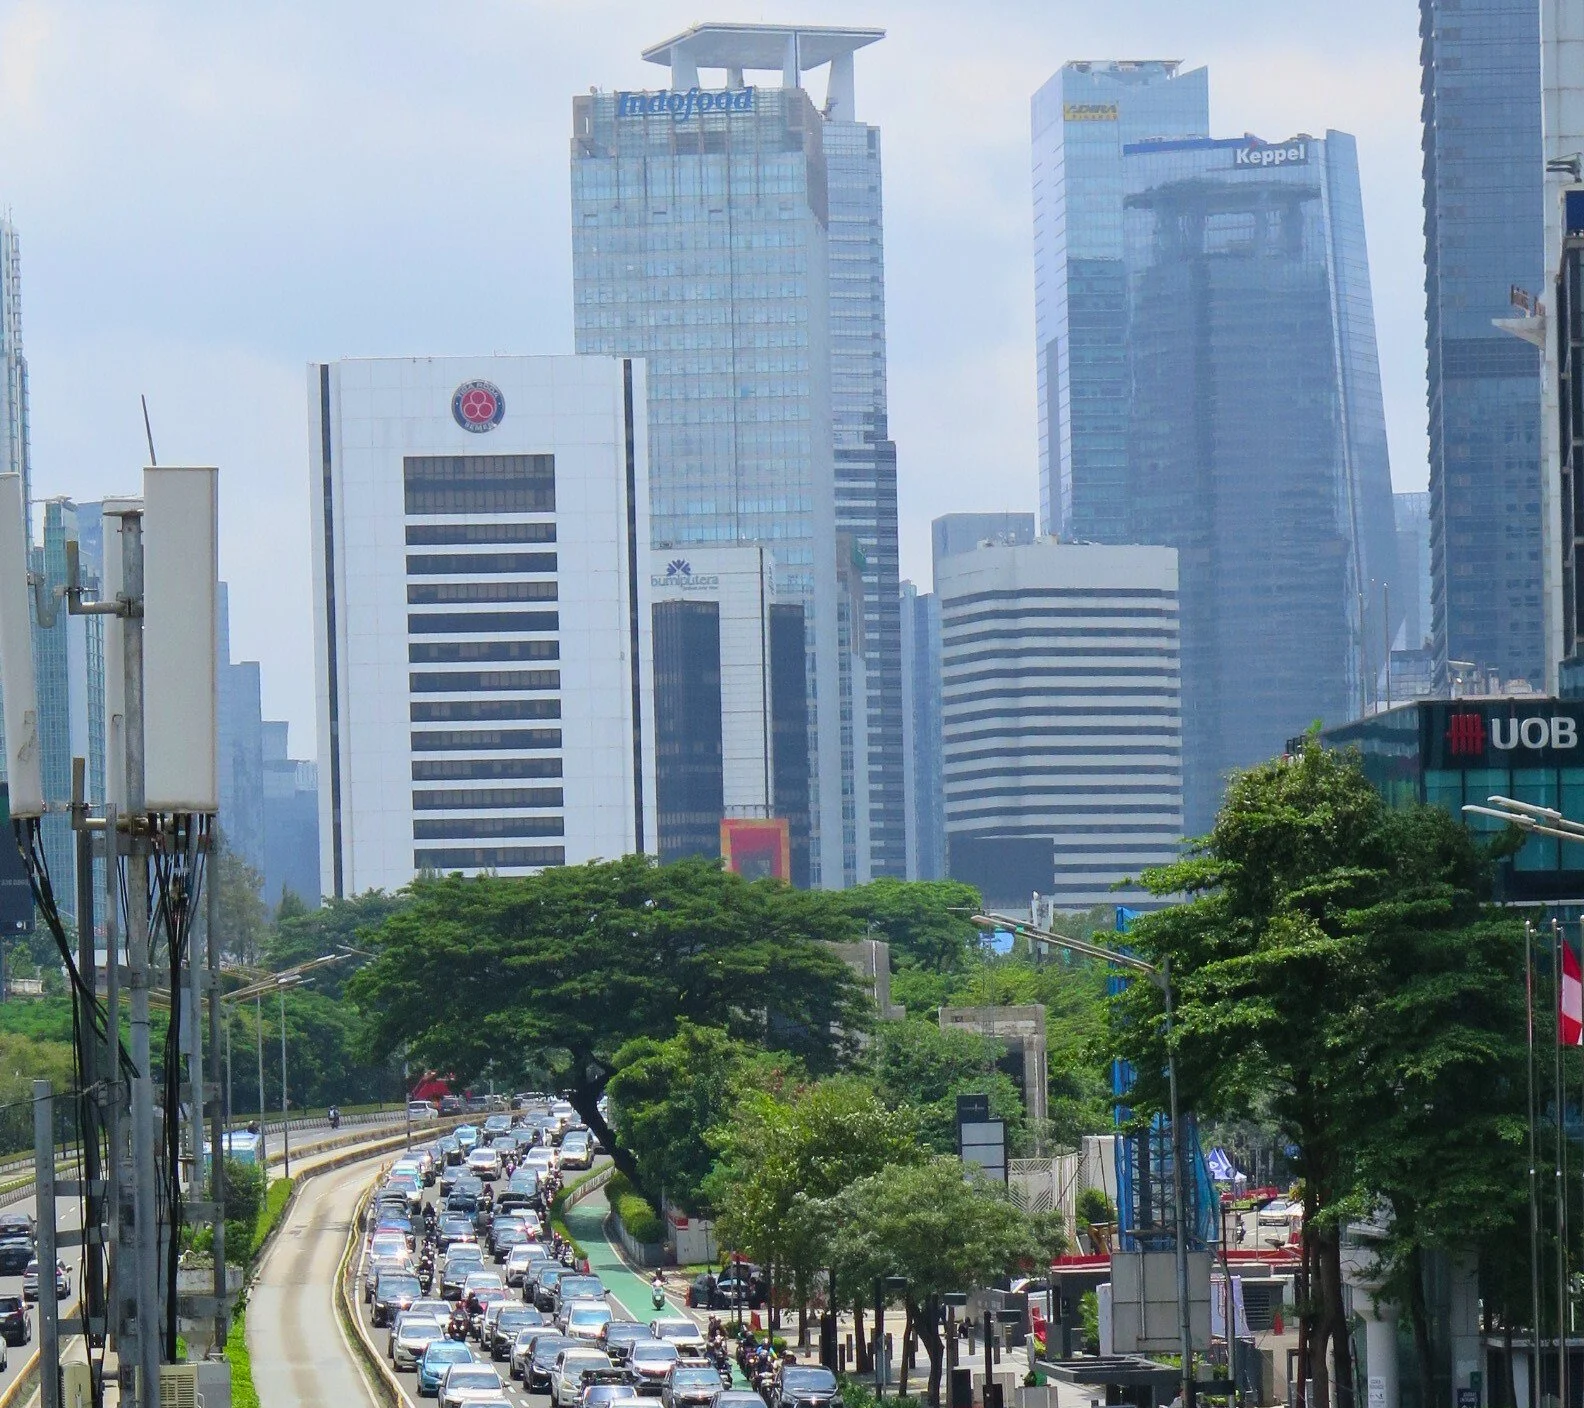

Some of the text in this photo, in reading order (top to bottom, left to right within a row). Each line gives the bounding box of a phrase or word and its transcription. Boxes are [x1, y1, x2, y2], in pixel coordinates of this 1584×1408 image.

[617, 86, 753, 123] Indofood
[1235, 143, 1305, 166] Keppel
[650, 573, 719, 588] bumiputera
[1491, 716, 1578, 750] UOB
